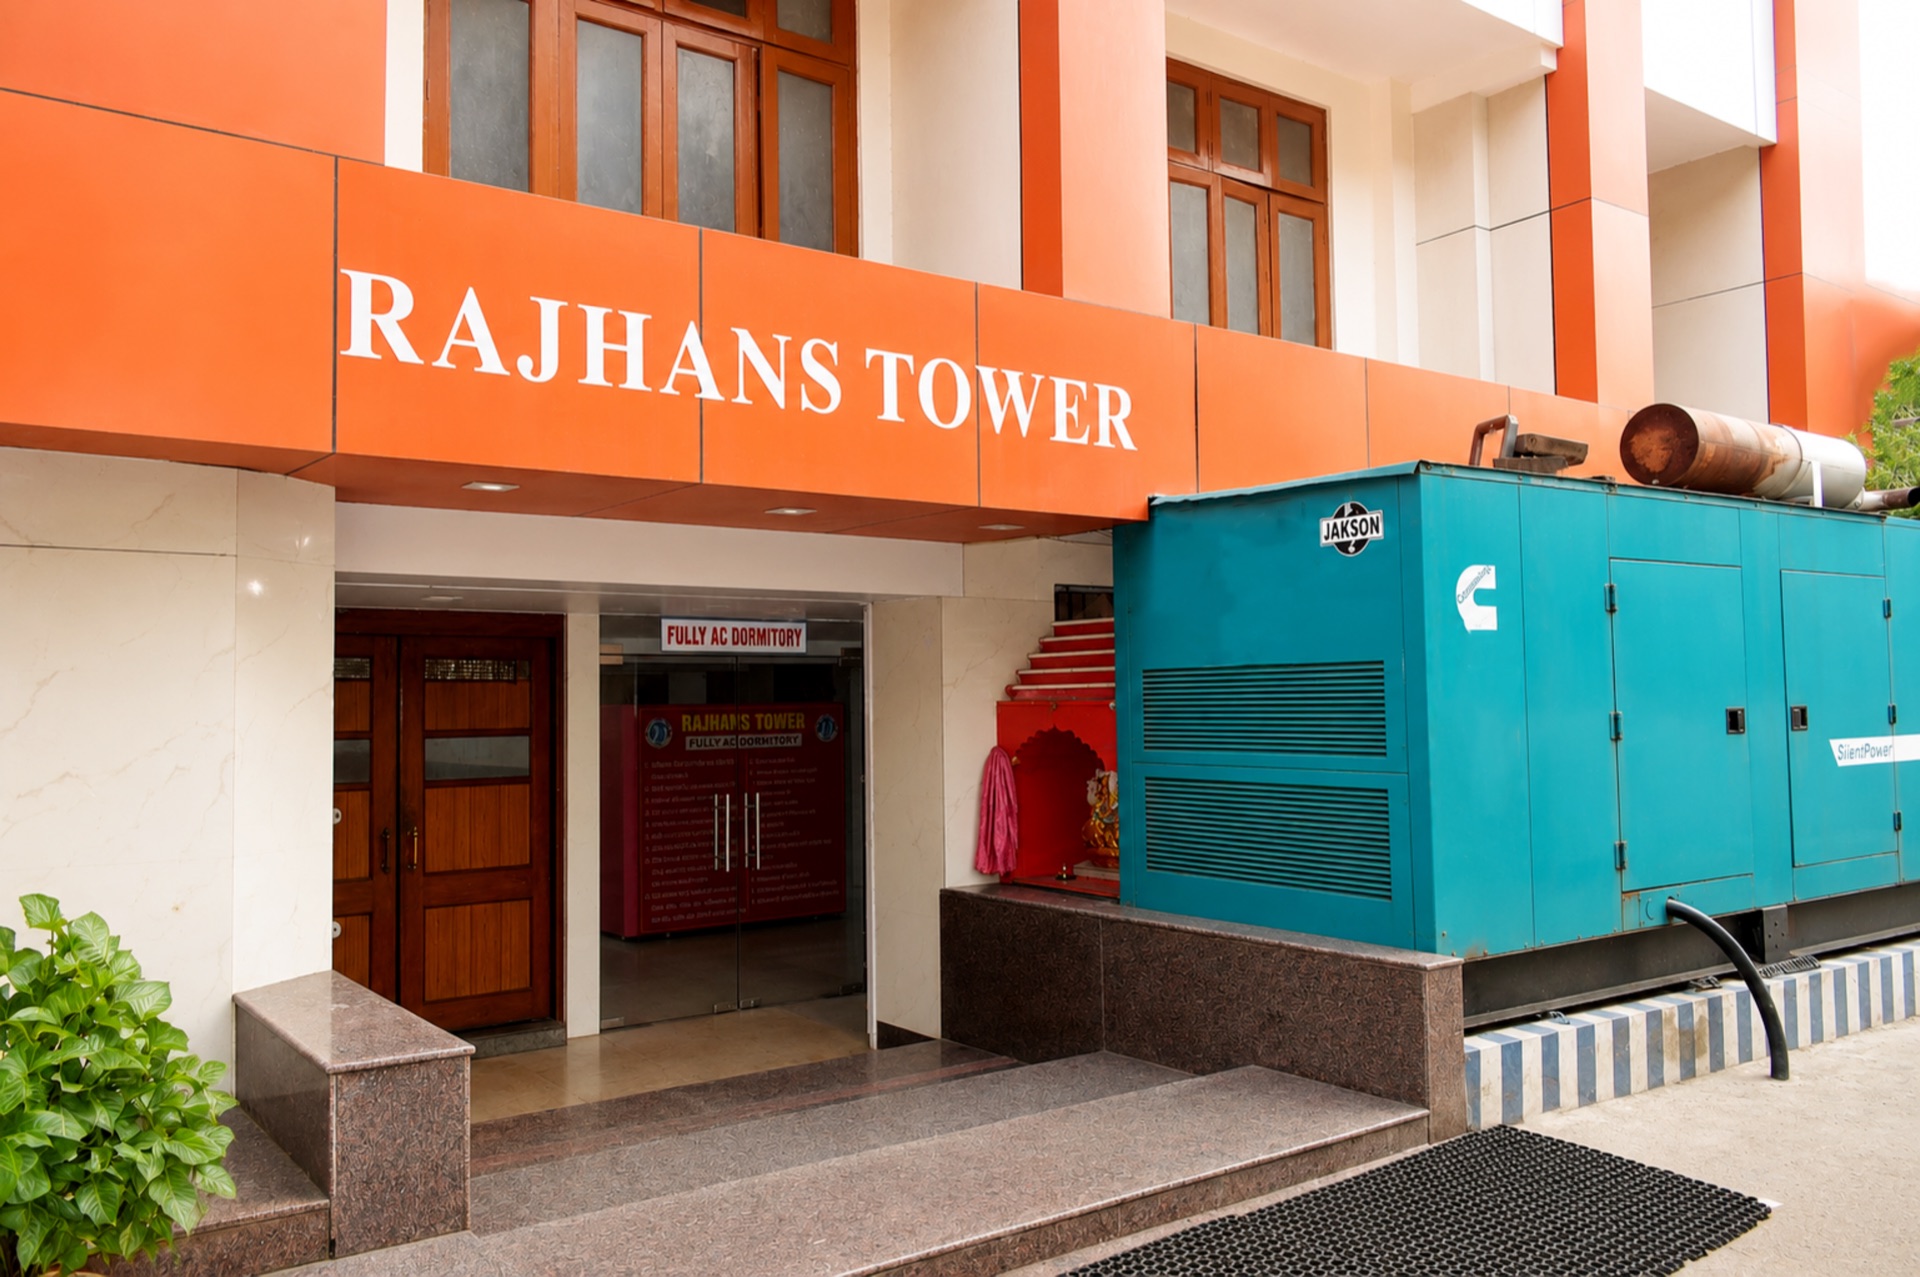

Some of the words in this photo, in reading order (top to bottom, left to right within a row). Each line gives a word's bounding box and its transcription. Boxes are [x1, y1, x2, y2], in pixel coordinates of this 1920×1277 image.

[339, 268, 842, 415] RAJHANS
[865, 347, 1138, 451] TOWER
[1324, 515, 1380, 541] JAKSON
[667, 625, 707, 646] FULLY
[711, 626, 728, 646] AC
[731, 626, 802, 647] DORMITORY
[681, 713, 750, 732] RAJHANS
[754, 712, 806, 731] TOWER
[688, 735, 720, 749] FULLY
[722, 736, 736, 747] AC
[739, 734, 800, 747] DORMITORY
